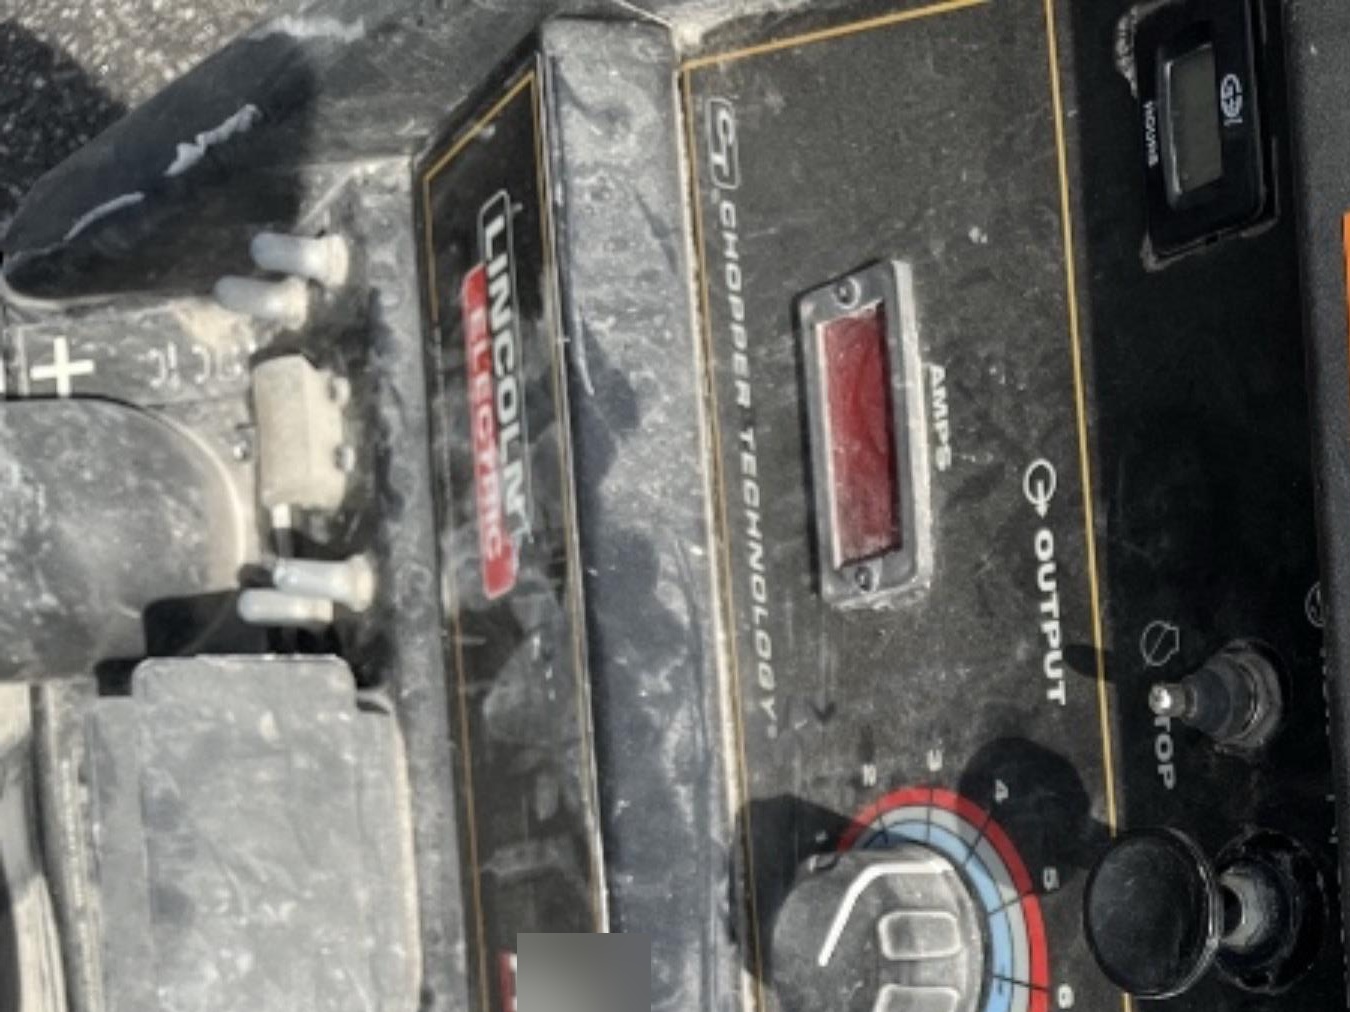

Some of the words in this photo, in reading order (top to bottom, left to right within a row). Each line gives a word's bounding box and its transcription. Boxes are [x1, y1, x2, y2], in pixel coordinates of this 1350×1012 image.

[718, 201, 751, 409] CHOPPER
[468, 306, 504, 562] ELECTRIC
[928, 361, 952, 472] AMPS
[1034, 527, 1066, 705] OUTPUT
[862, 762, 879, 788] 2
[926, 748, 943, 772] 3
[1153, 714, 1175, 790] TOP
[994, 778, 1010, 803] 4
[1043, 866, 1060, 891] 5
[1056, 983, 1075, 1010] 6
